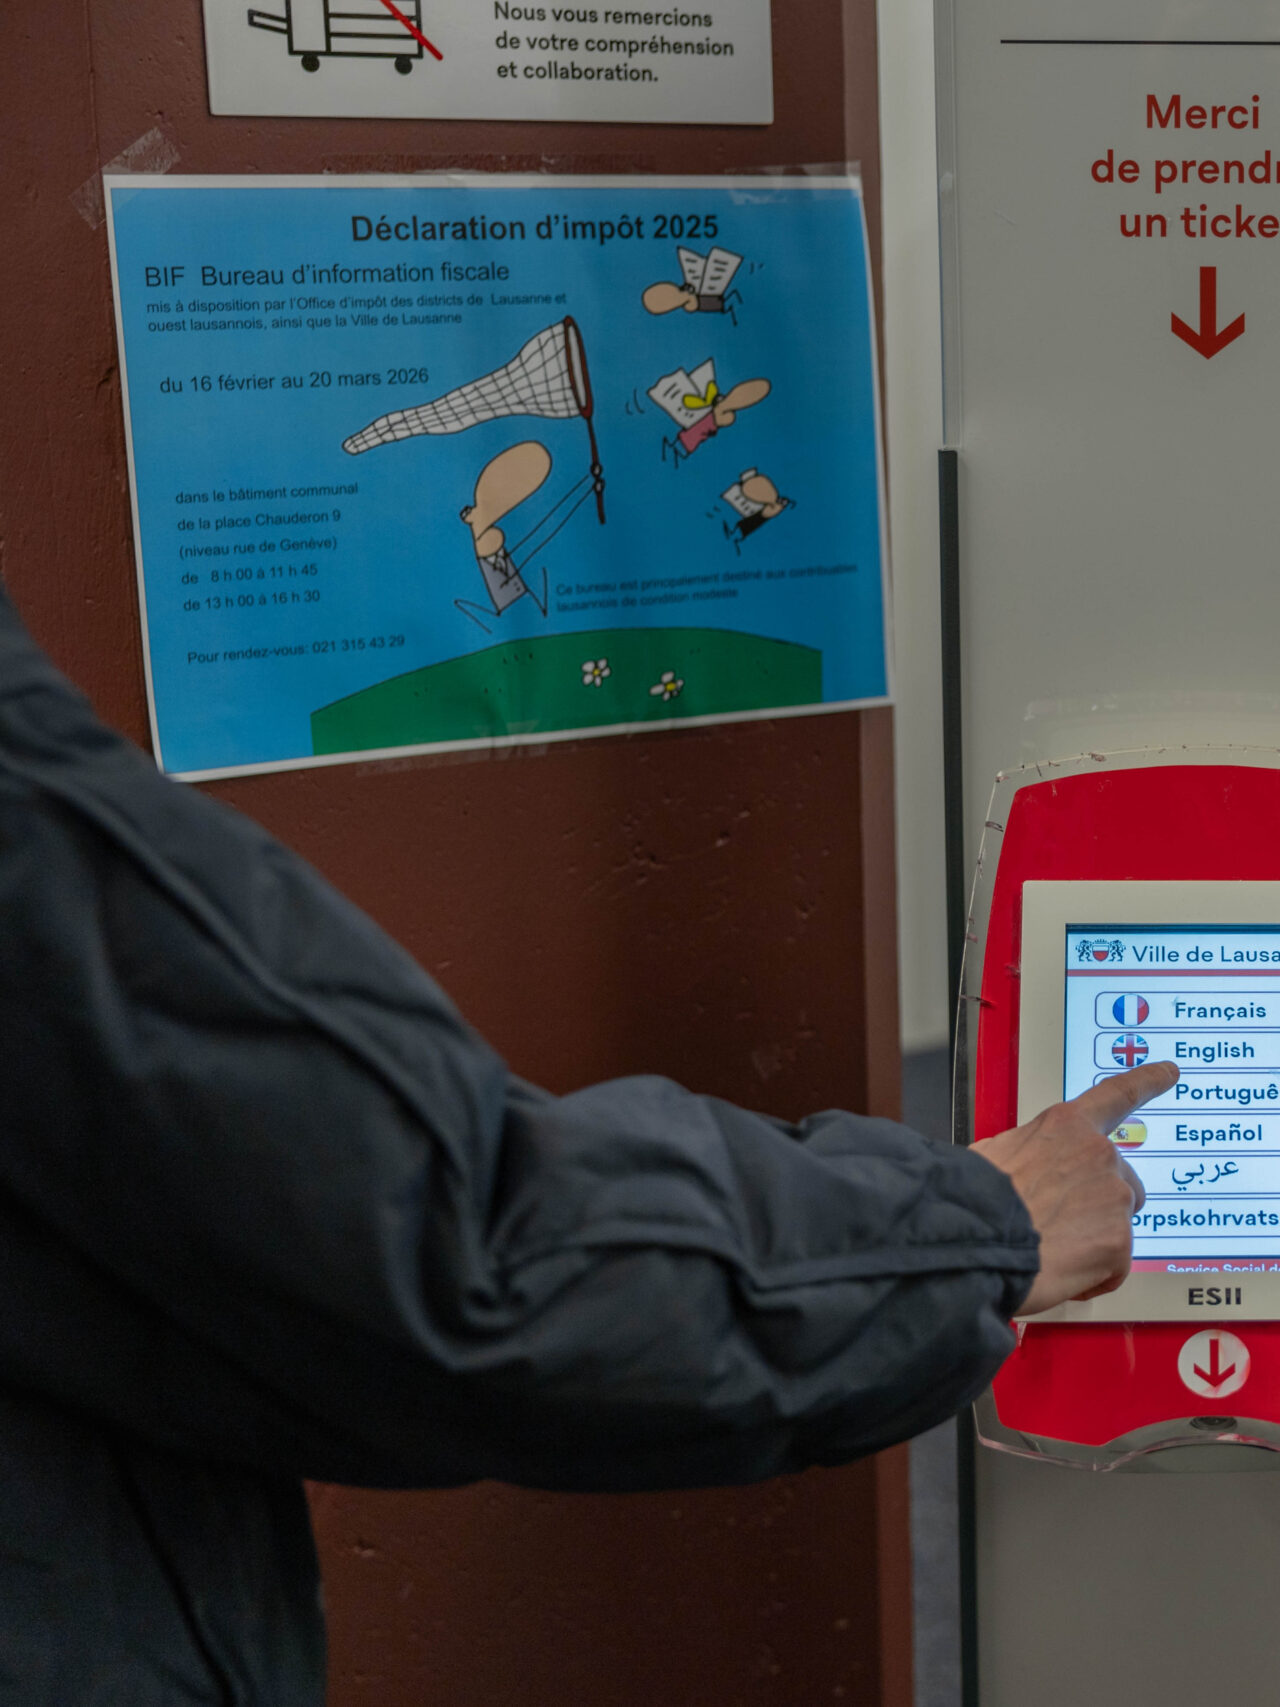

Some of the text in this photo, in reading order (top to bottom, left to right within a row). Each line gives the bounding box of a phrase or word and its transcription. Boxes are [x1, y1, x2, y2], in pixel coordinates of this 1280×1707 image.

[494, 1, 713, 28] Nous vous remercions
[495, 31, 735, 58] de votre compréhension
[497, 61, 659, 82] et collaboration.
[1146, 94, 1260, 129] Merci
[1090, 149, 1140, 184] de
[351, 215, 719, 245] Déclaration d'impôt 2025
[1120, 213, 1167, 238] un
[144, 261, 510, 288] BIF Bureau d'information fiscale
[146, 292, 567, 315] mis à disposition par l'Office d'impôt des districts de Lausanne et
[148, 312, 463, 333] ouest lausannois, ainsi que la Ville de Lausanne
[159, 369, 429, 393] du 16 février au 20 mars 2026
[175, 482, 359, 504] dans le bâtiment communal
[177, 510, 341, 532] de la place Chauderon 9
[178, 536, 338, 560] (niveau rue de Genève)
[181, 564, 318, 585] de 8 h 00 à 11 h 45
[555, 583, 572, 596] Ce
[575, 582, 616, 594] bureau
[619, 580, 638, 591] est
[640, 573, 719, 592] principalement
[183, 590, 321, 612] de 13 h 00 à 16 h 30
[621, 596, 638, 608] de
[640, 592, 690, 606] condition
[187, 635, 405, 665] Pour rendez-vous: 021 315 43 29
[1132, 945, 1180, 963] Ville
[1185, 945, 1214, 963] de
[1174, 1002, 1267, 1022] Français
[1174, 1041, 1255, 1062] English
[1176, 1124, 1263, 1147] Español
[1171, 1160, 1239, 1191] عربي
[1167, 1264, 1220, 1272] Service
[1222, 1263, 1265, 1272] Social
[1187, 1287, 1243, 1306] ESII
